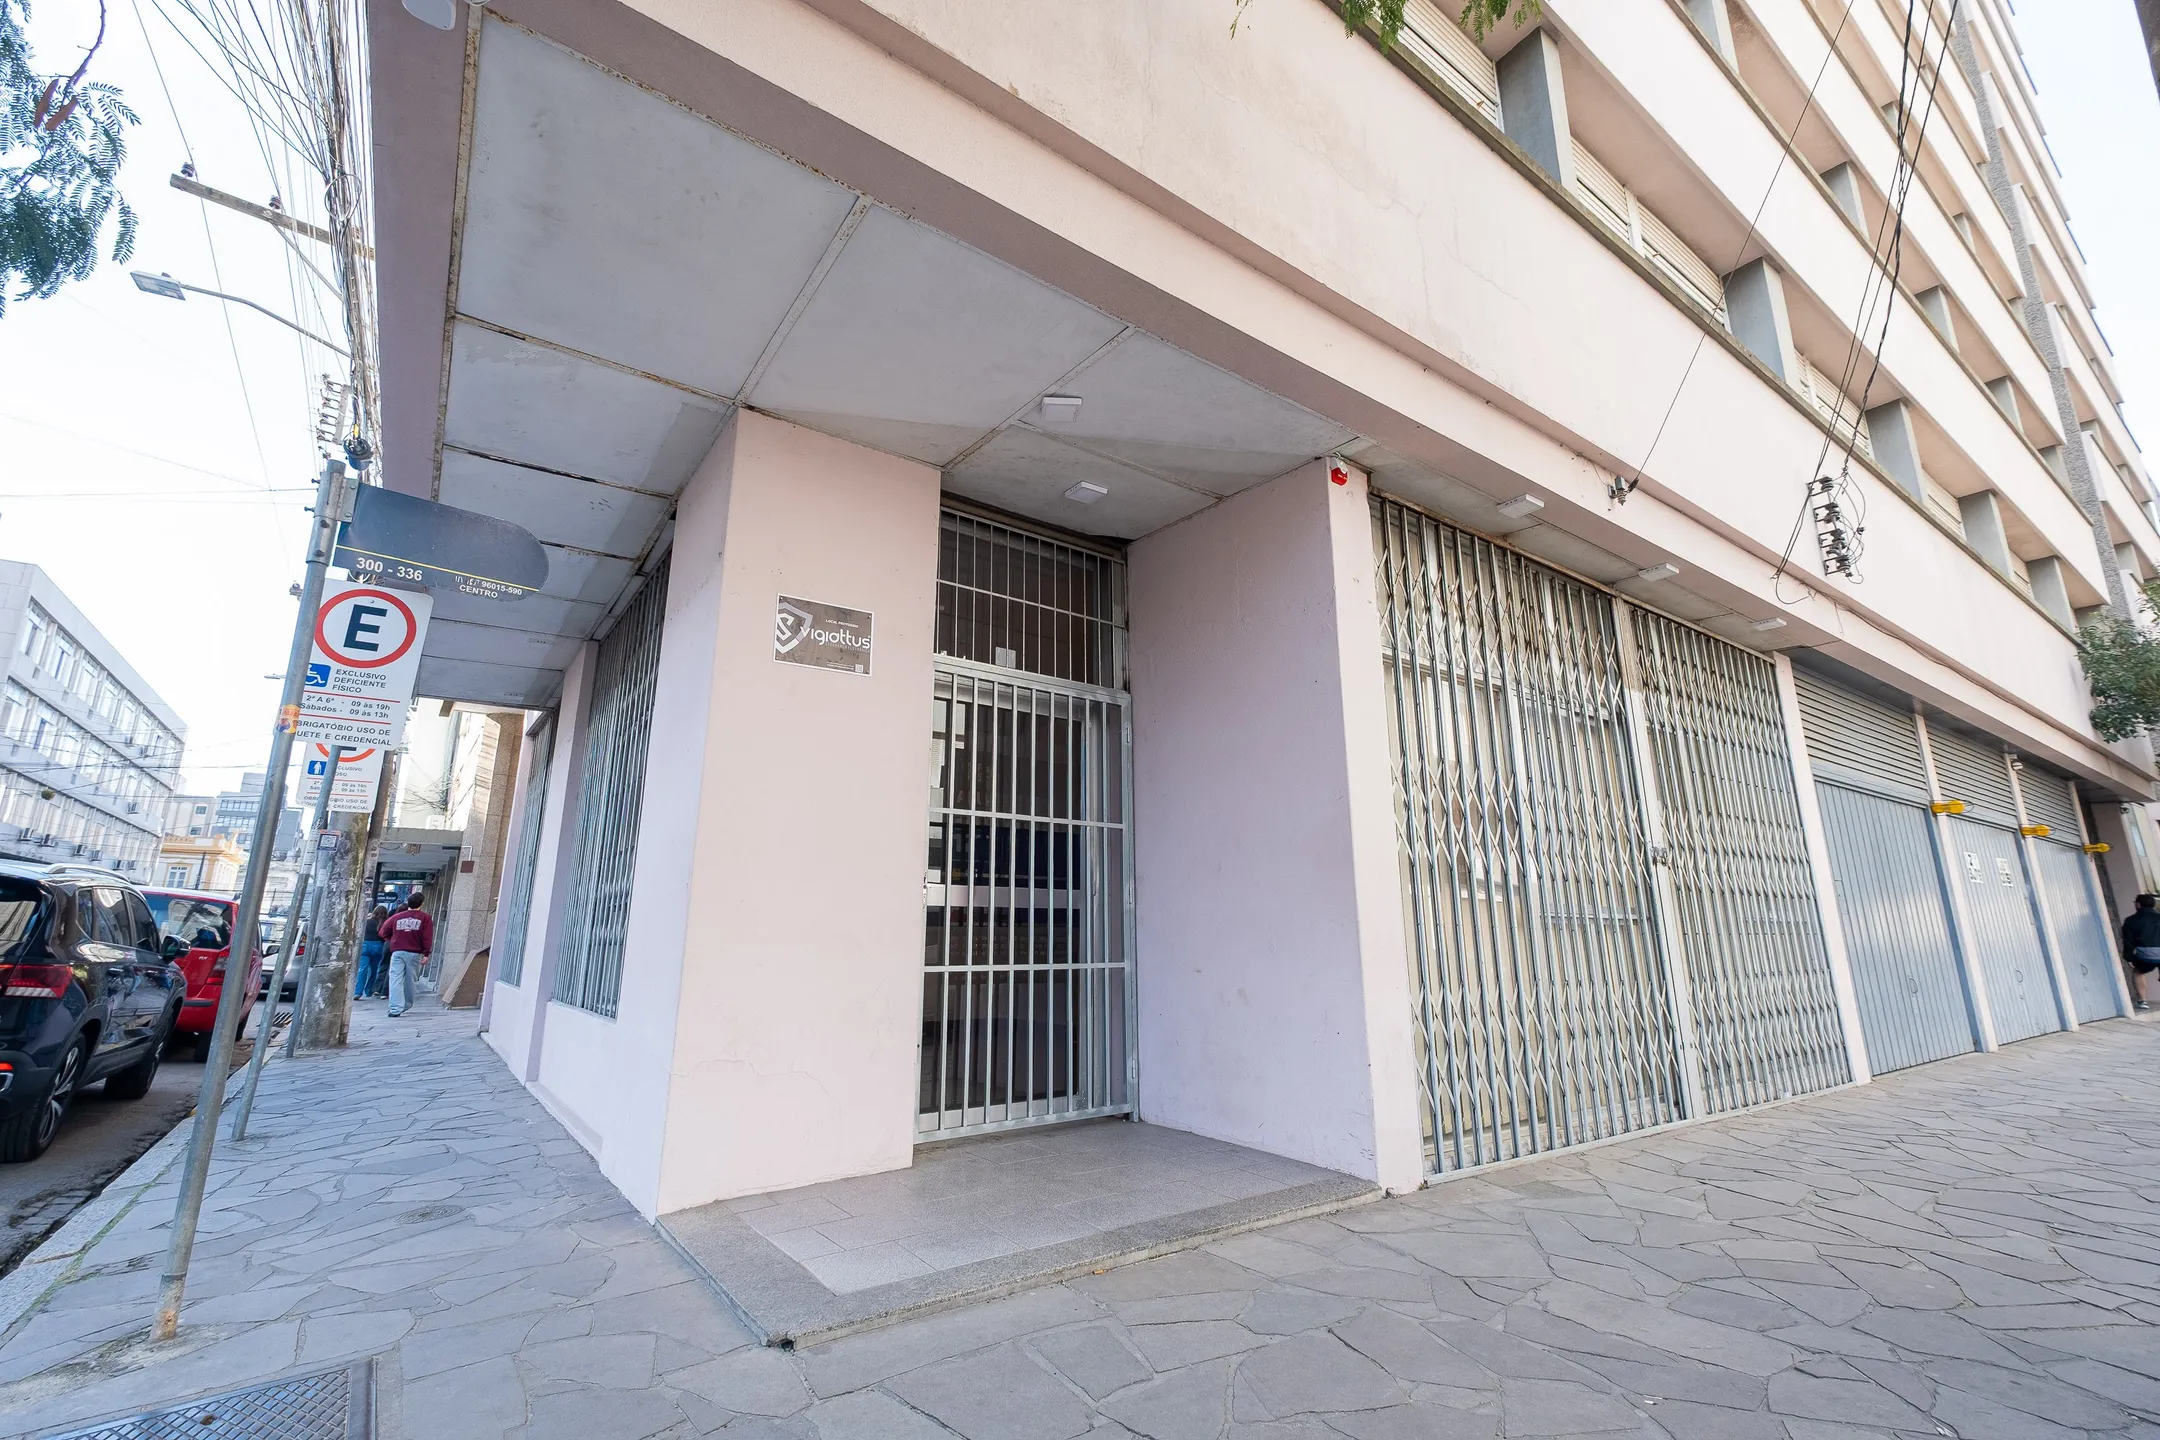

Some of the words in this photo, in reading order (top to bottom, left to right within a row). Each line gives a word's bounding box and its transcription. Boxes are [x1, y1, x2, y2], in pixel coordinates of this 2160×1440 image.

[356, 557, 383, 573] 300
[396, 566, 423, 582] 336
[459, 584, 498, 599] CENTRO
[481, 581, 523, 596] 96015-590
[343, 604, 388, 652] E
[336, 668, 387, 680] EXCLUSIVO
[332, 684, 362, 693] FÍSICO
[334, 676, 386, 689] DEFICIENTE
[300, 702, 337, 713] Sábados
[361, 709, 371, 717] às
[363, 701, 373, 709] às
[376, 703, 391, 711] 19h
[296, 730, 321, 739] UETE
[334, 734, 392, 746] CREDENCIAL
[356, 726, 376, 734] USO
[378, 728, 391, 736] DE
